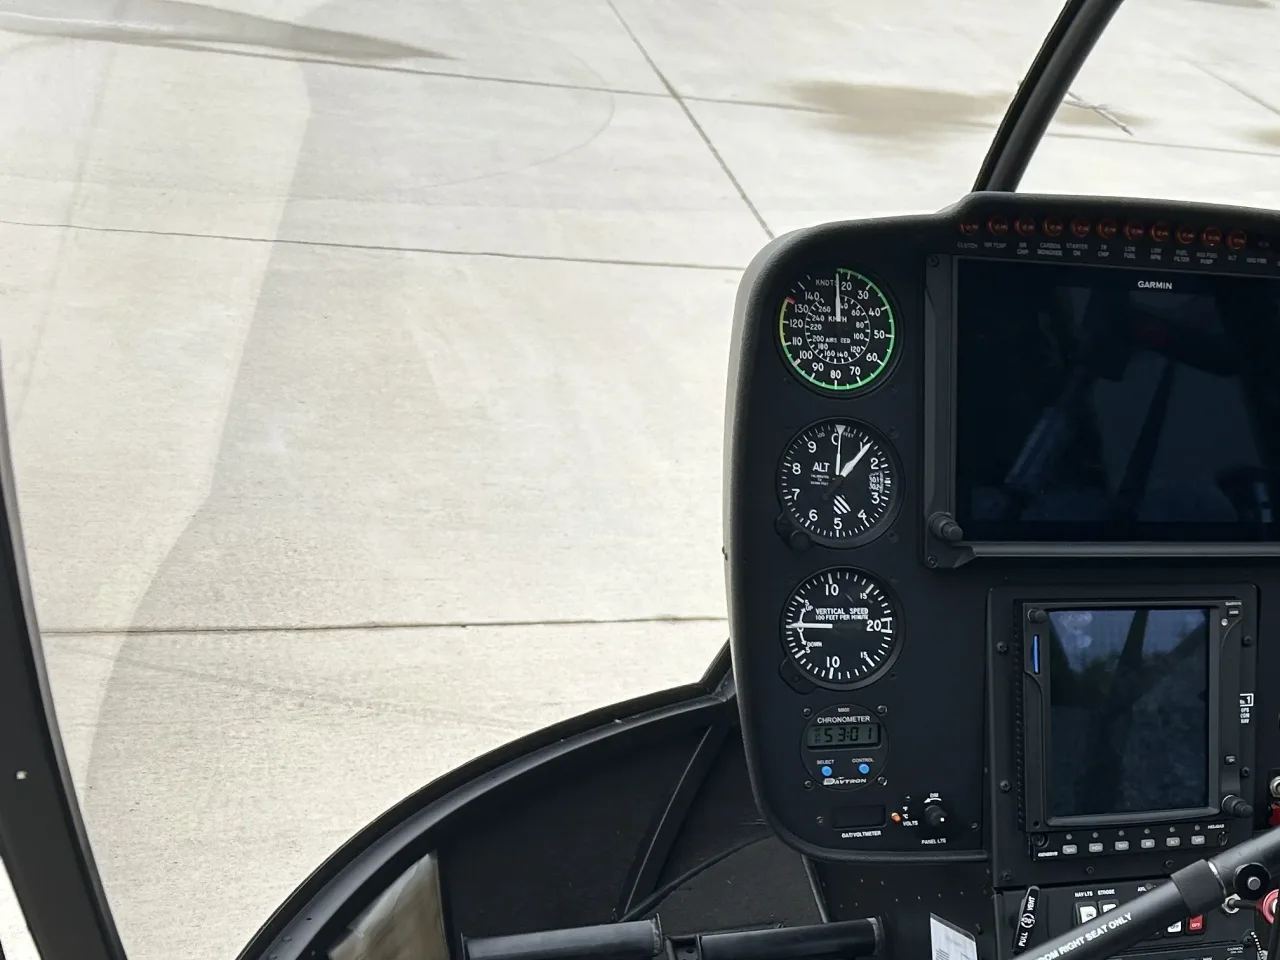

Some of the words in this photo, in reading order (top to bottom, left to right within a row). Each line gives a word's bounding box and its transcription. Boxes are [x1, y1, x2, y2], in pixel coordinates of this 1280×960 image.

[841, 282, 852, 290] 20
[1137, 281, 1173, 290] GARMIN
[805, 292, 820, 301] 140
[857, 291, 869, 300] 30
[795, 304, 809, 313] 130
[869, 308, 881, 317] 40
[789, 319, 803, 328] 120
[873, 330, 885, 339] 50
[792, 337, 802, 346] 110
[799, 351, 813, 360] 100
[866, 353, 878, 362] 60
[812, 362, 824, 372] 90
[850, 366, 861, 376] 70
[830, 370, 841, 379] 80
[807, 441, 817, 453] 9
[792, 462, 801, 475] 8
[812, 461, 830, 472] ALT
[870, 457, 879, 470] 2
[792, 488, 800, 501] 7
[871, 492, 880, 504] 3
[809, 509, 818, 521] 6
[857, 509, 867, 521] 4
[833, 517, 842, 530] 5
[825, 583, 839, 596] 10
[849, 607, 869, 615] SPEED
[866, 619, 882, 632] 20
[860, 651, 868, 659] 15
[826, 656, 840, 668] 10
[817, 716, 871, 724] CHRONOMETER
[1027, 896, 1036, 912] VENT
[1058, 936, 1085, 955] RIGHT
[1085, 925, 1109, 941] SEAT
[1108, 912, 1132, 929] ONLY
[1018, 931, 1028, 947] PULL
